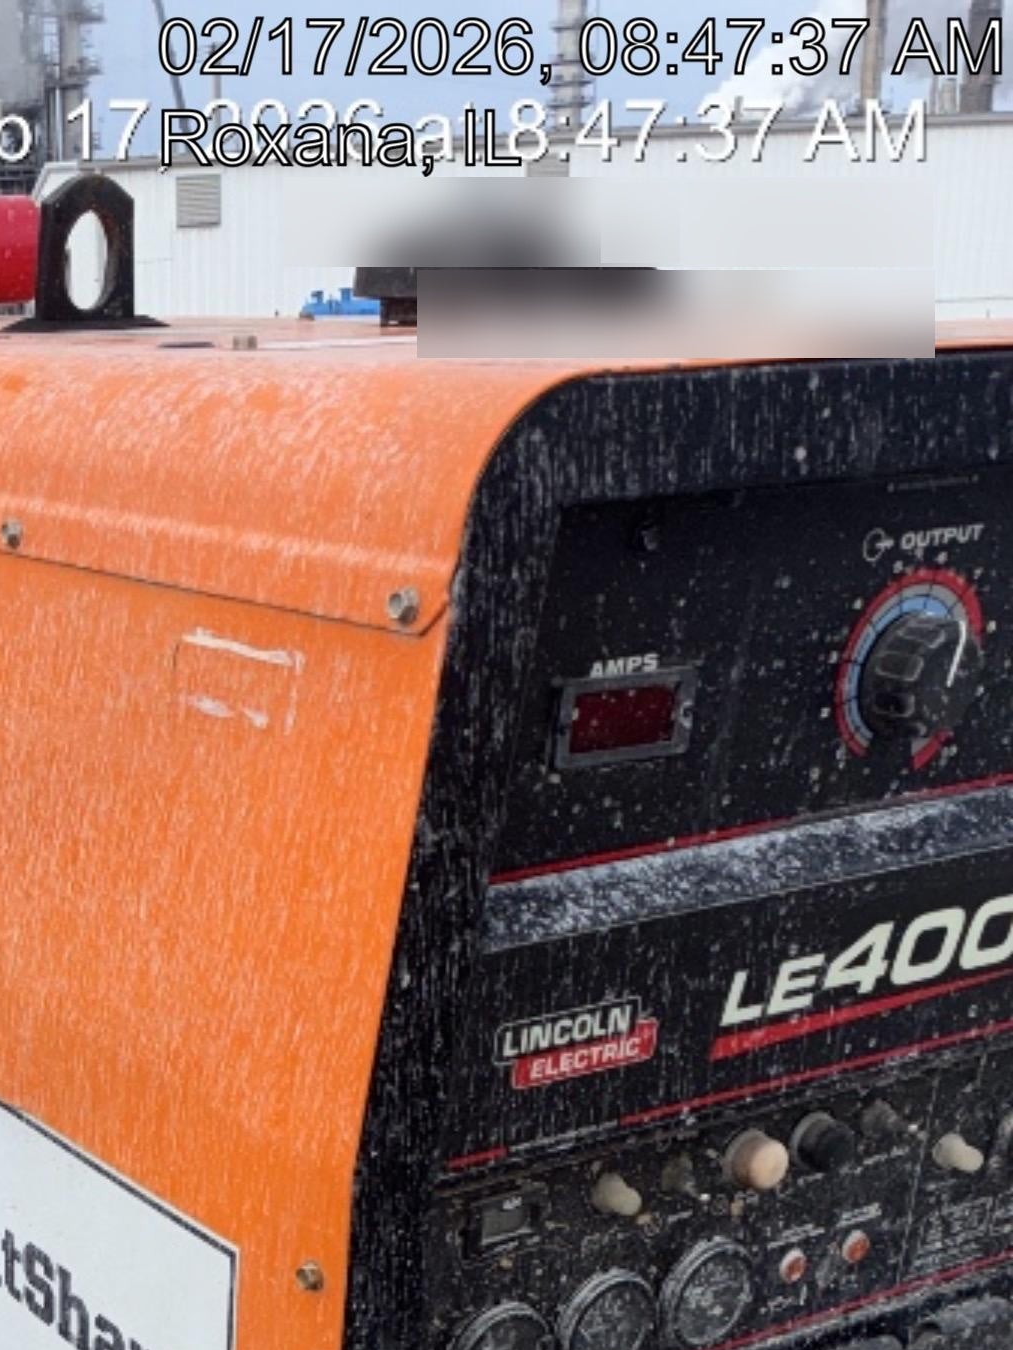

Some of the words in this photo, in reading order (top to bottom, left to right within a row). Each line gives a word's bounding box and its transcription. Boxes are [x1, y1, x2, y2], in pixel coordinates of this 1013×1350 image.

[900, 524, 984, 551] OUTPUT
[589, 653, 660, 679] AMPS
[719, 895, 1013, 1028] LE400
[502, 1004, 633, 1057] LINCOLN
[529, 1037, 642, 1080] ELECTRIC
